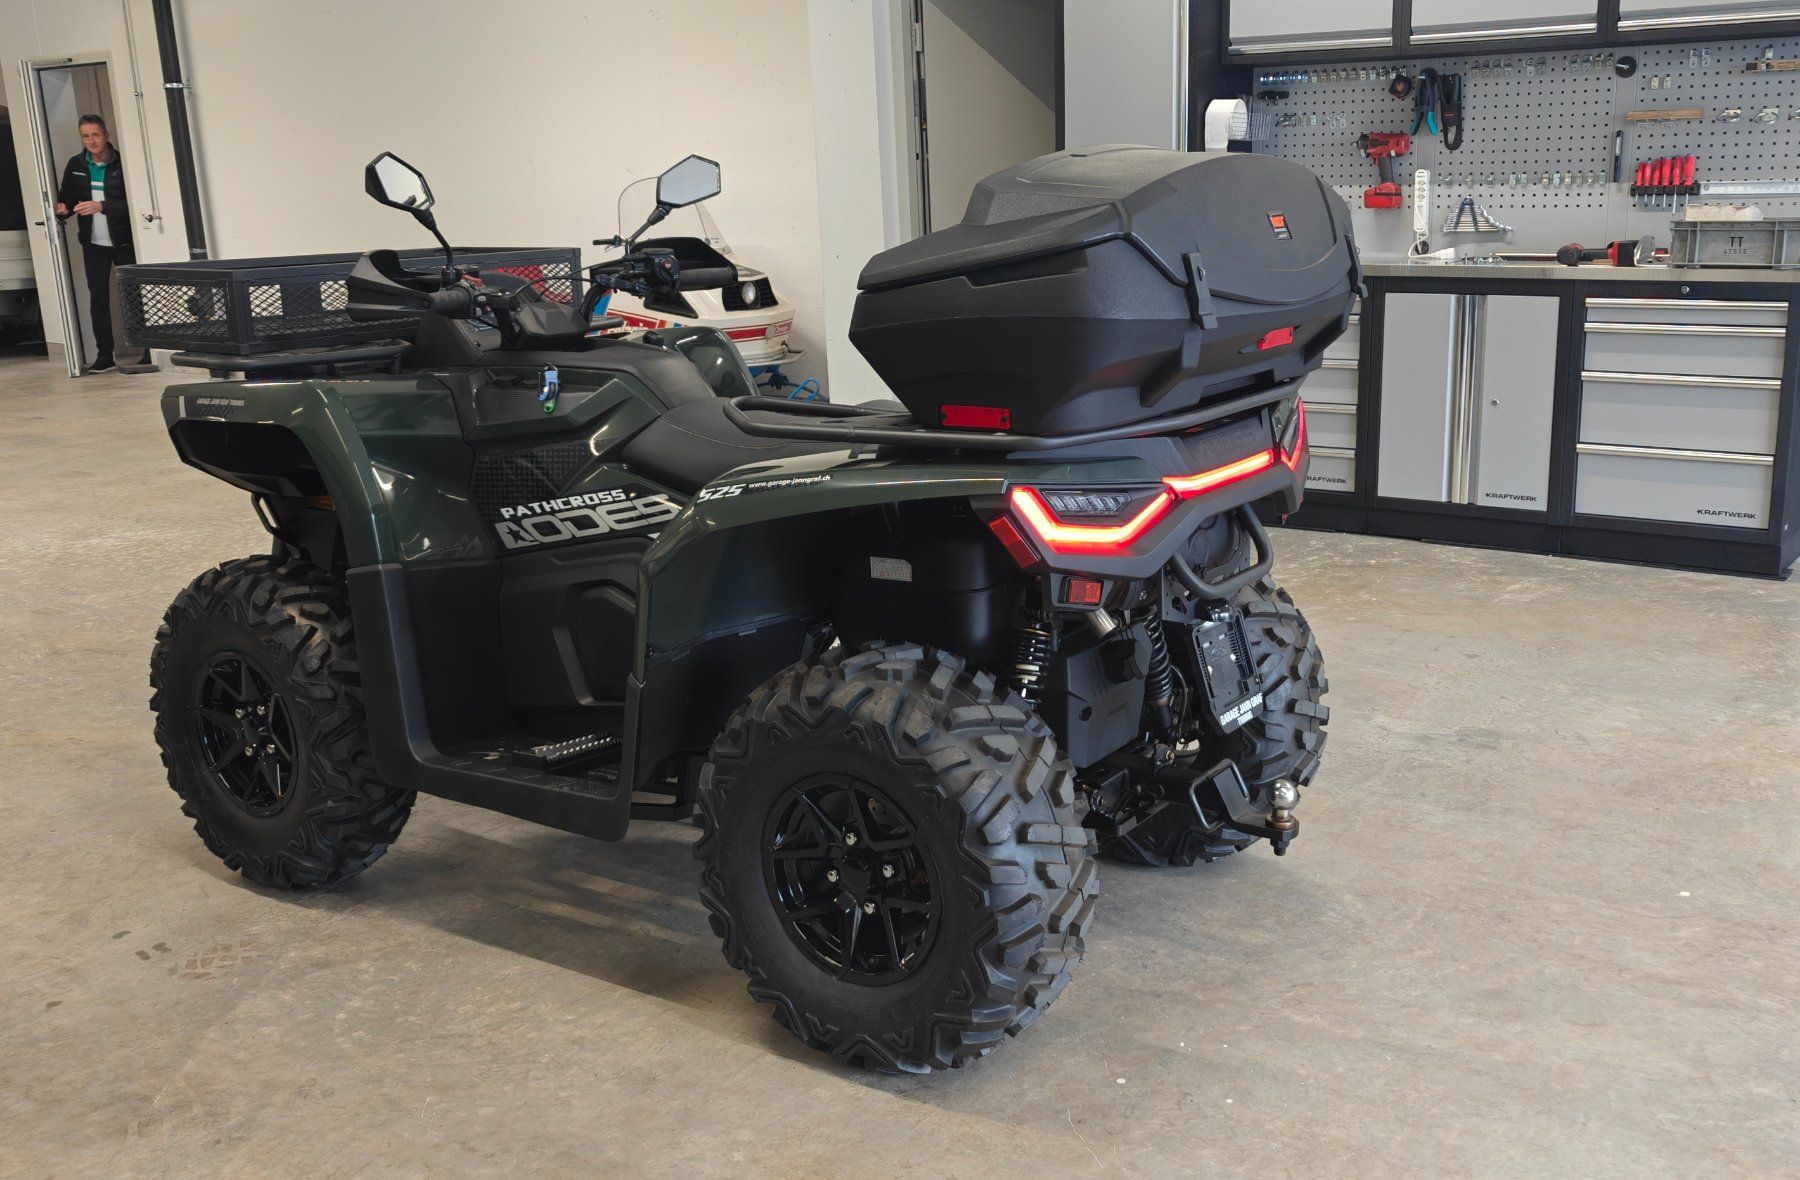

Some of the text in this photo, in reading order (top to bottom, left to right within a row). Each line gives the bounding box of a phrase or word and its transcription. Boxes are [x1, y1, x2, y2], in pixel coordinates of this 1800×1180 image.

[1729, 236, 1744, 248] TT
[1306, 475, 1348, 484] RAFTWERK
[697, 475, 831, 503] 525 www.garage-janngraf.ch
[1485, 492, 1538, 502] KRAFTWERK
[500, 489, 627, 519] PATHCROSS
[1696, 509, 1757, 519] KRAFTWERK
